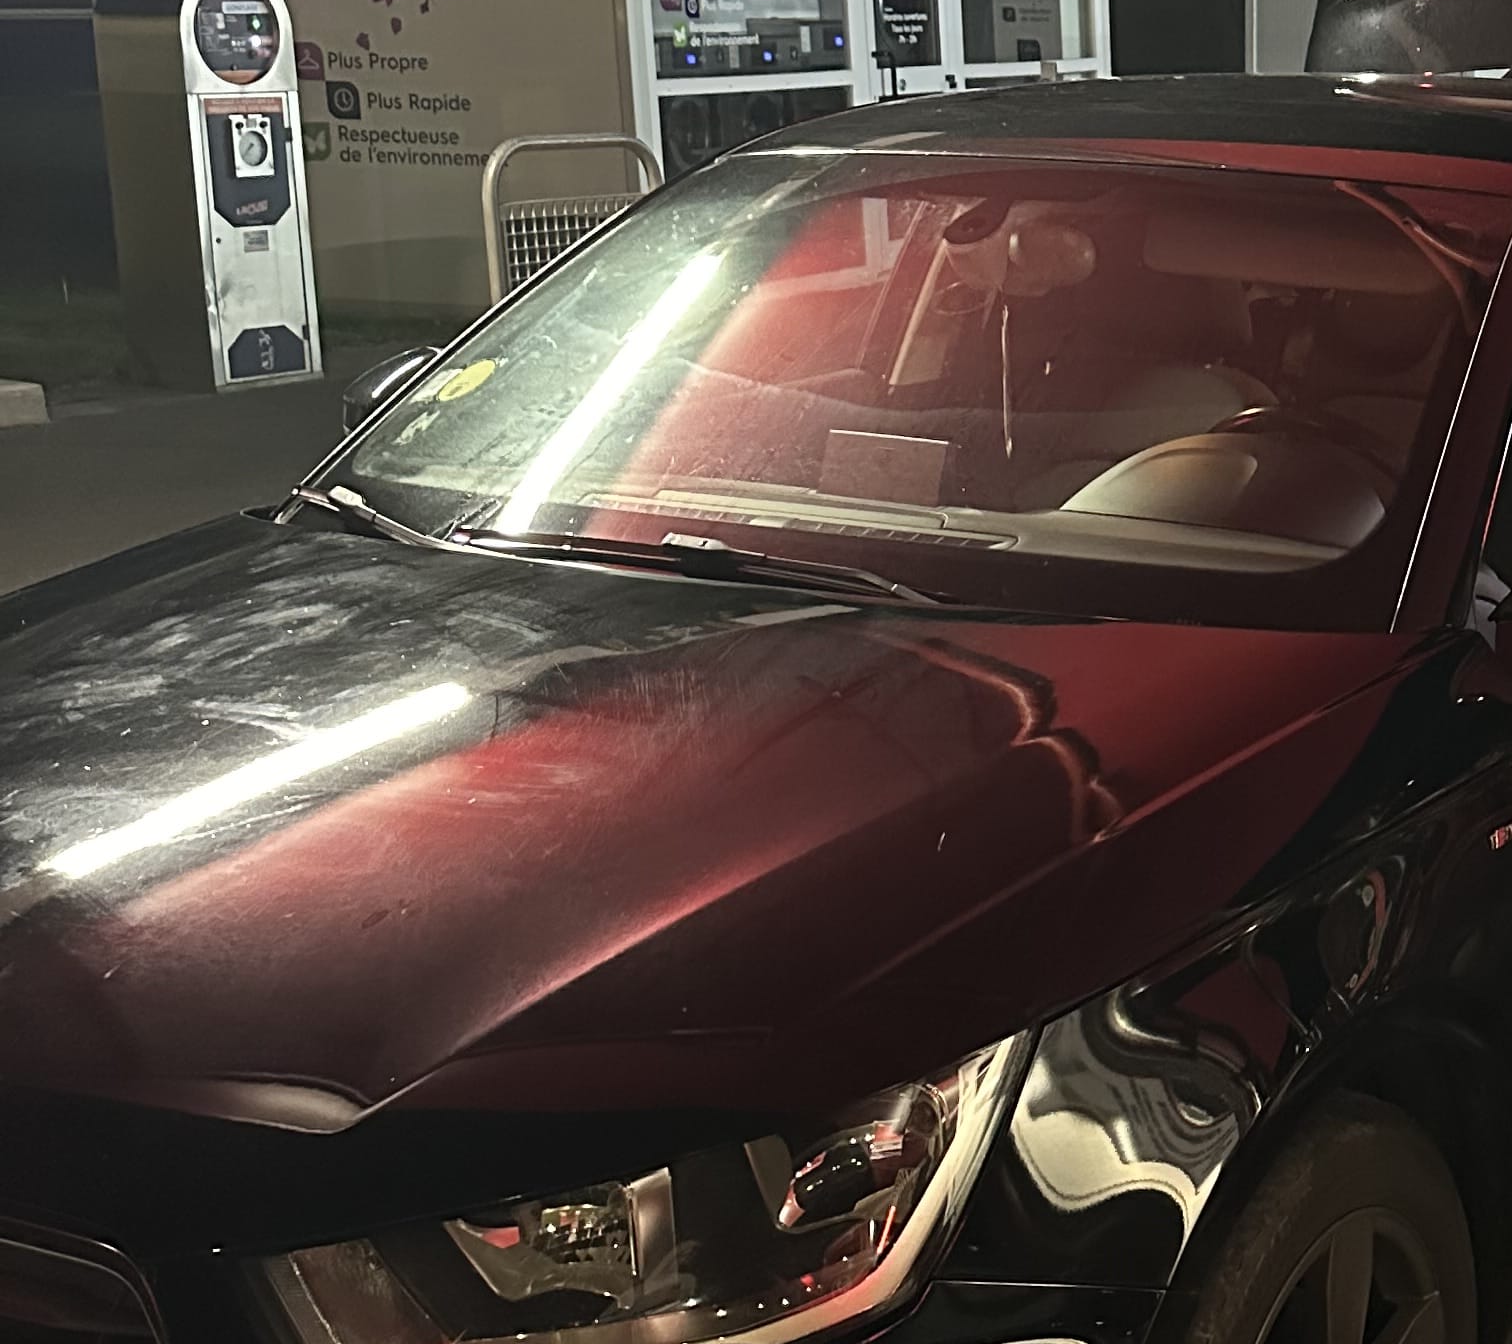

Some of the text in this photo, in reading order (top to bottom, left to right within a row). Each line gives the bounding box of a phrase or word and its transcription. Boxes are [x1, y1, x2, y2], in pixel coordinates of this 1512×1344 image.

[327, 51, 429, 73] Plus Propre
[367, 91, 472, 114] Plus Rapide
[338, 125, 460, 145] Respectueuse
[340, 146, 498, 167] de l'environneme
